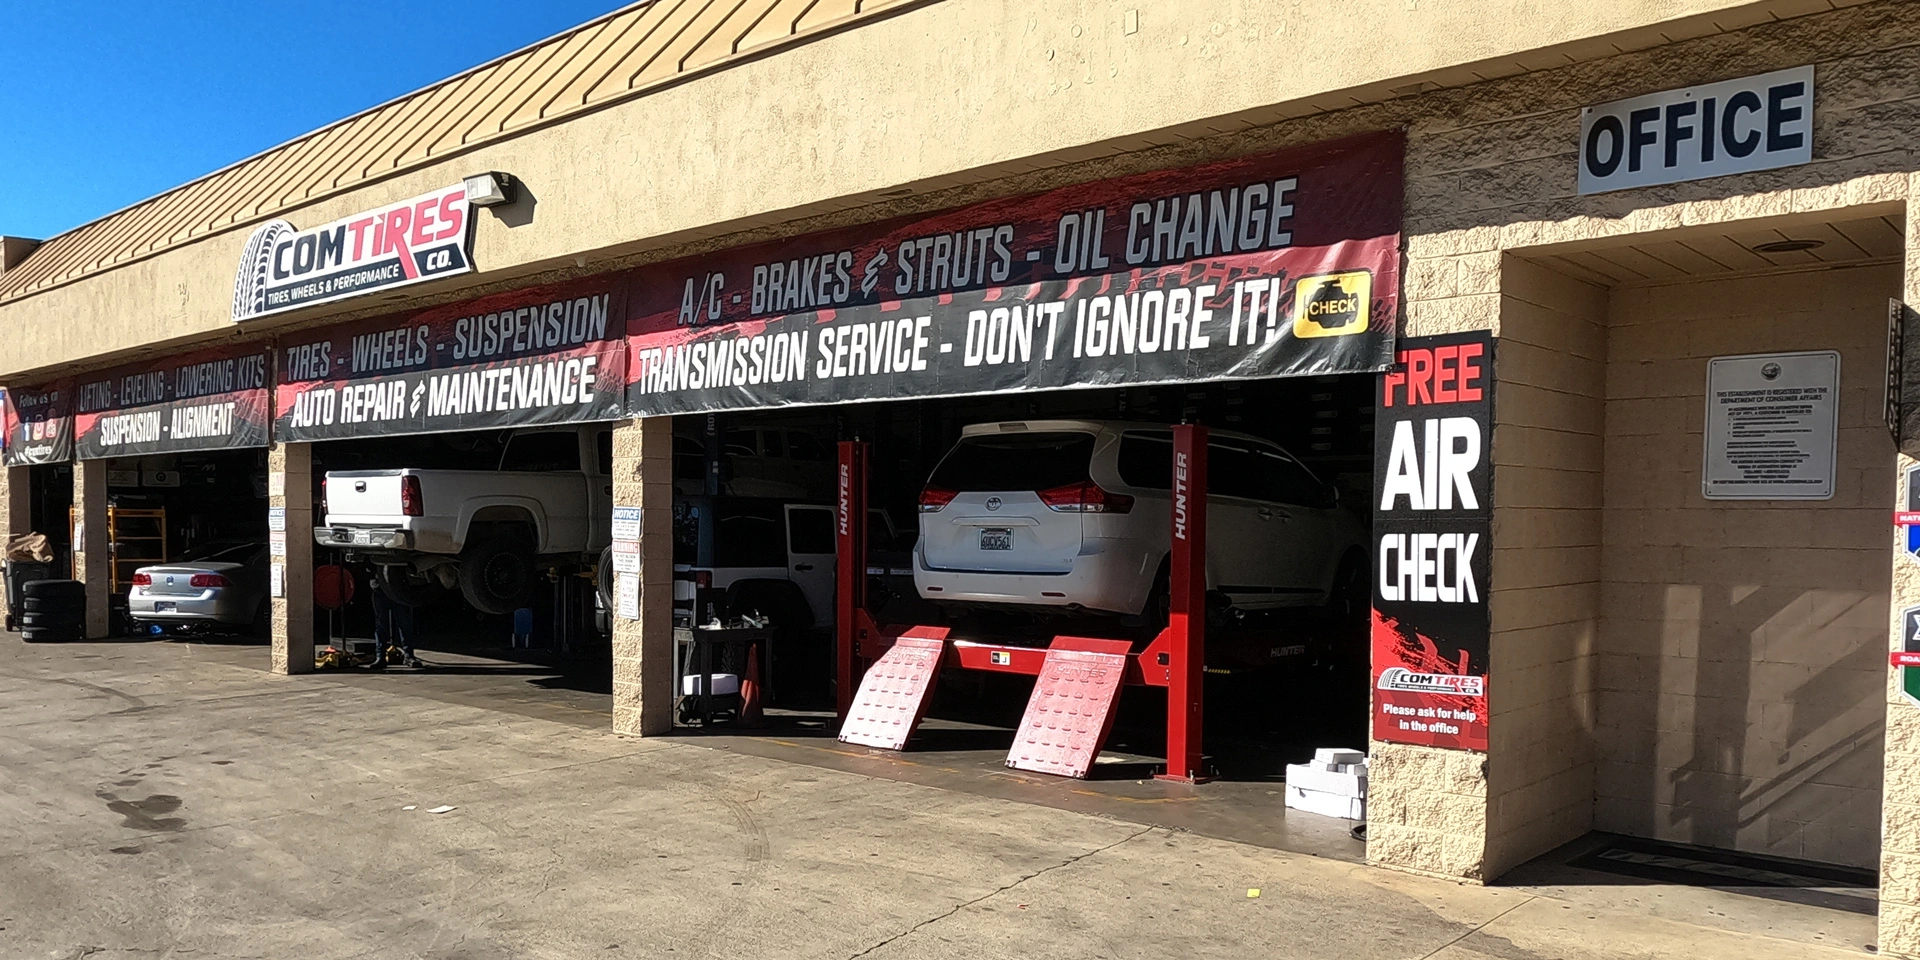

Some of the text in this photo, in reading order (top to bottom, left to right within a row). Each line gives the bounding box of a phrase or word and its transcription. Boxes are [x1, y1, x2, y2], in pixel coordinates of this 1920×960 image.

[1586, 81, 1805, 178] OFFICE
[426, 249, 452, 271] CO.
[678, 177, 1298, 326] A/C - BRAKES & STRUTS - OIL CHANGE
[267, 263, 399, 305] TIRES, WHEELS & PERFORMANCE
[1309, 300, 1356, 315] CHECK
[286, 341, 332, 382] TIRES
[352, 324, 429, 374] WHEELS
[453, 293, 609, 361] SUSPENSION
[639, 277, 1281, 396] TRANSMISSION SERVICE - DON'T IGNORE IT!
[79, 380, 111, 412] LIFTING
[120, 371, 164, 406] LEVELING
[175, 359, 233, 399] LOWERING
[237, 354, 265, 389] KITS
[291, 356, 597, 429] AUTO REPAIR & MAINTENANCE
[1384, 343, 1483, 407] FREE
[100, 410, 161, 447] SUSPENSION
[170, 402, 235, 441] ALIGNMENT
[1380, 416, 1482, 511] AIR
[614, 508, 639, 520] NOTICE
[840, 463, 848, 535] HUNTER
[1175, 452, 1187, 540] HUNTER
[1380, 532, 1480, 603] CHECK
[1270, 645, 1305, 657] HUNTER
[1383, 703, 1476, 722] Please ask for help
[1410, 721, 1427, 732] the
[1429, 722, 1458, 734] office
